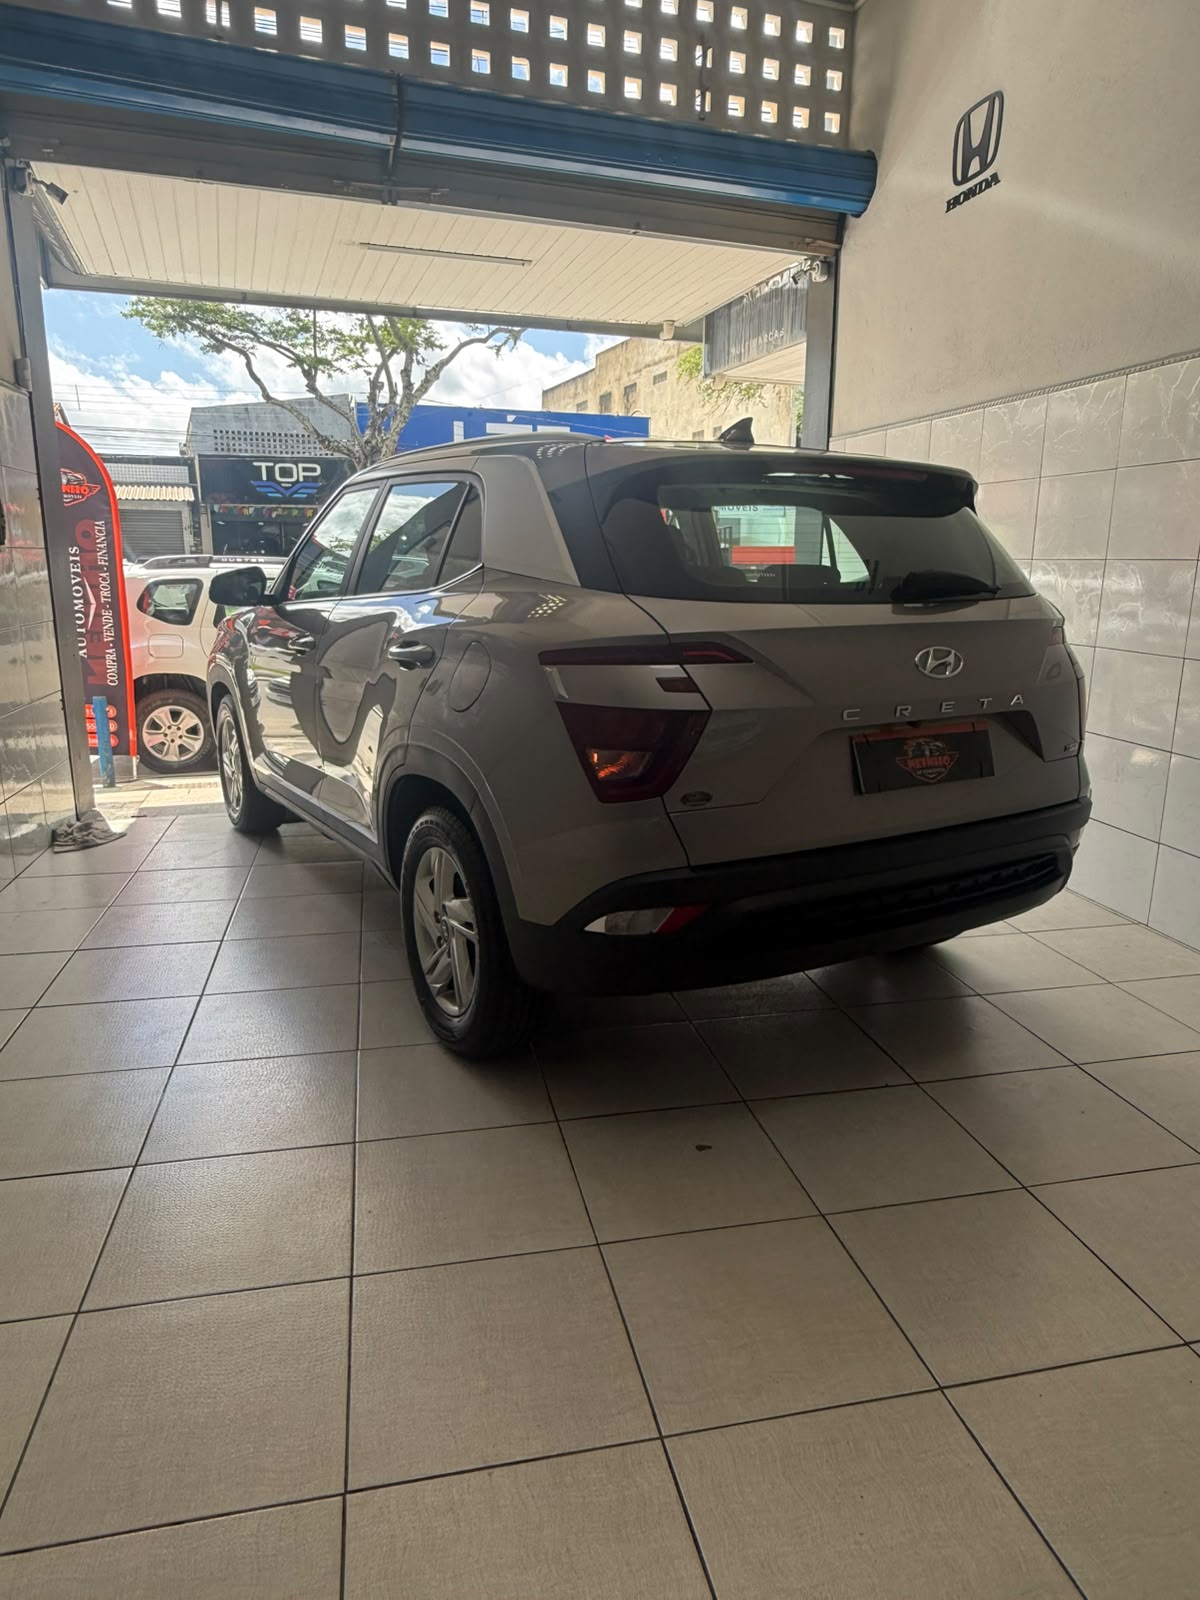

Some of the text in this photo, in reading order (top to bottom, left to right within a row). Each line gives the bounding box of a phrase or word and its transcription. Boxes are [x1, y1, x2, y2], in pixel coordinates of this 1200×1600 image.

[945, 172, 1001, 213] HONDA
[252, 462, 321, 482] TOP
[94, 520, 109, 567] FINANCIA
[99, 571, 112, 604] TROCA
[103, 609, 115, 642] VENDE
[106, 644, 119, 687] COMPRA
[843, 694, 1024, 721] CRETA
